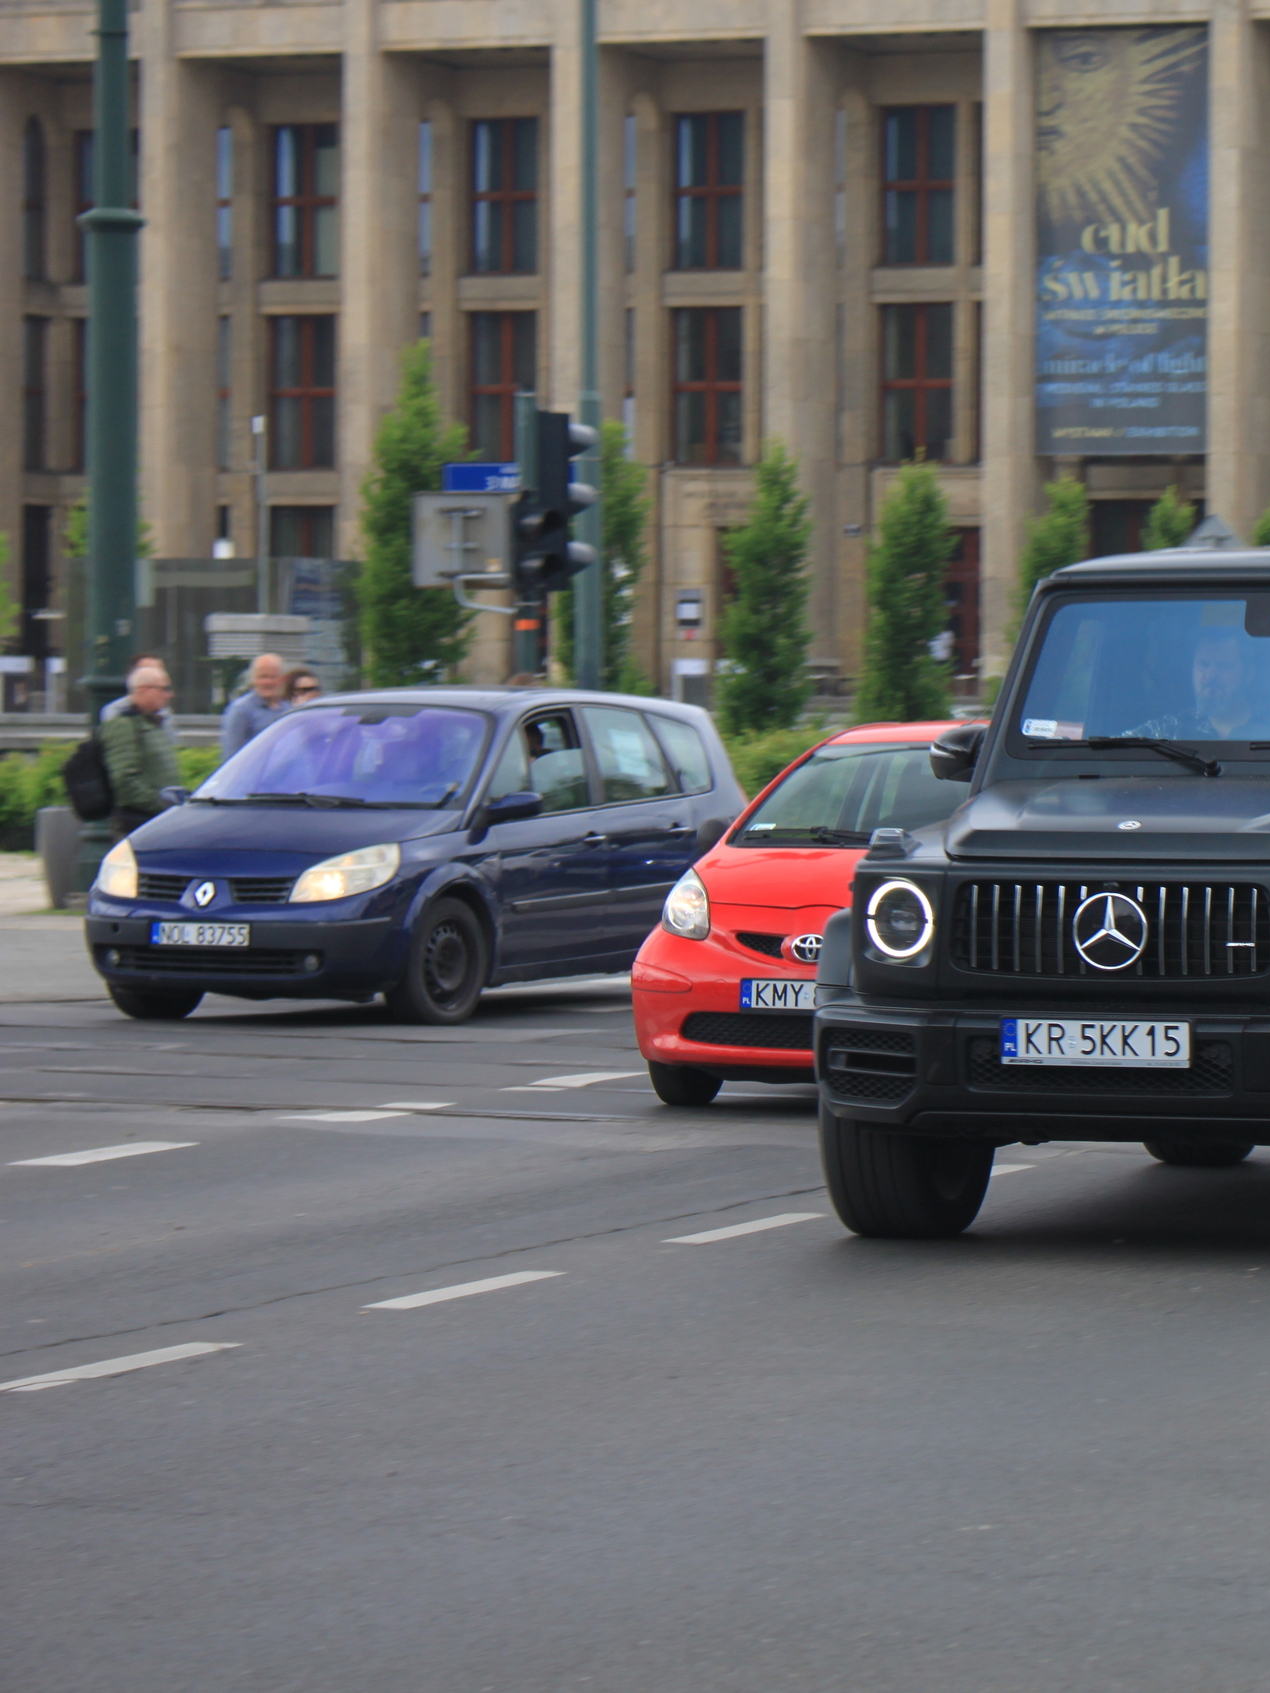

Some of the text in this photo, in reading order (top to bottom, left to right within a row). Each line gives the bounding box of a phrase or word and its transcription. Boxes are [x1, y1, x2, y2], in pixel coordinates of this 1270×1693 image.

[1081, 207, 1170, 254] cud
[161, 925, 247, 945] NOL 83755
[742, 997, 751, 1005] PL
[755, 982, 805, 1008] KMY
[1005, 1022, 1181, 1057] PL KR 5KK15
